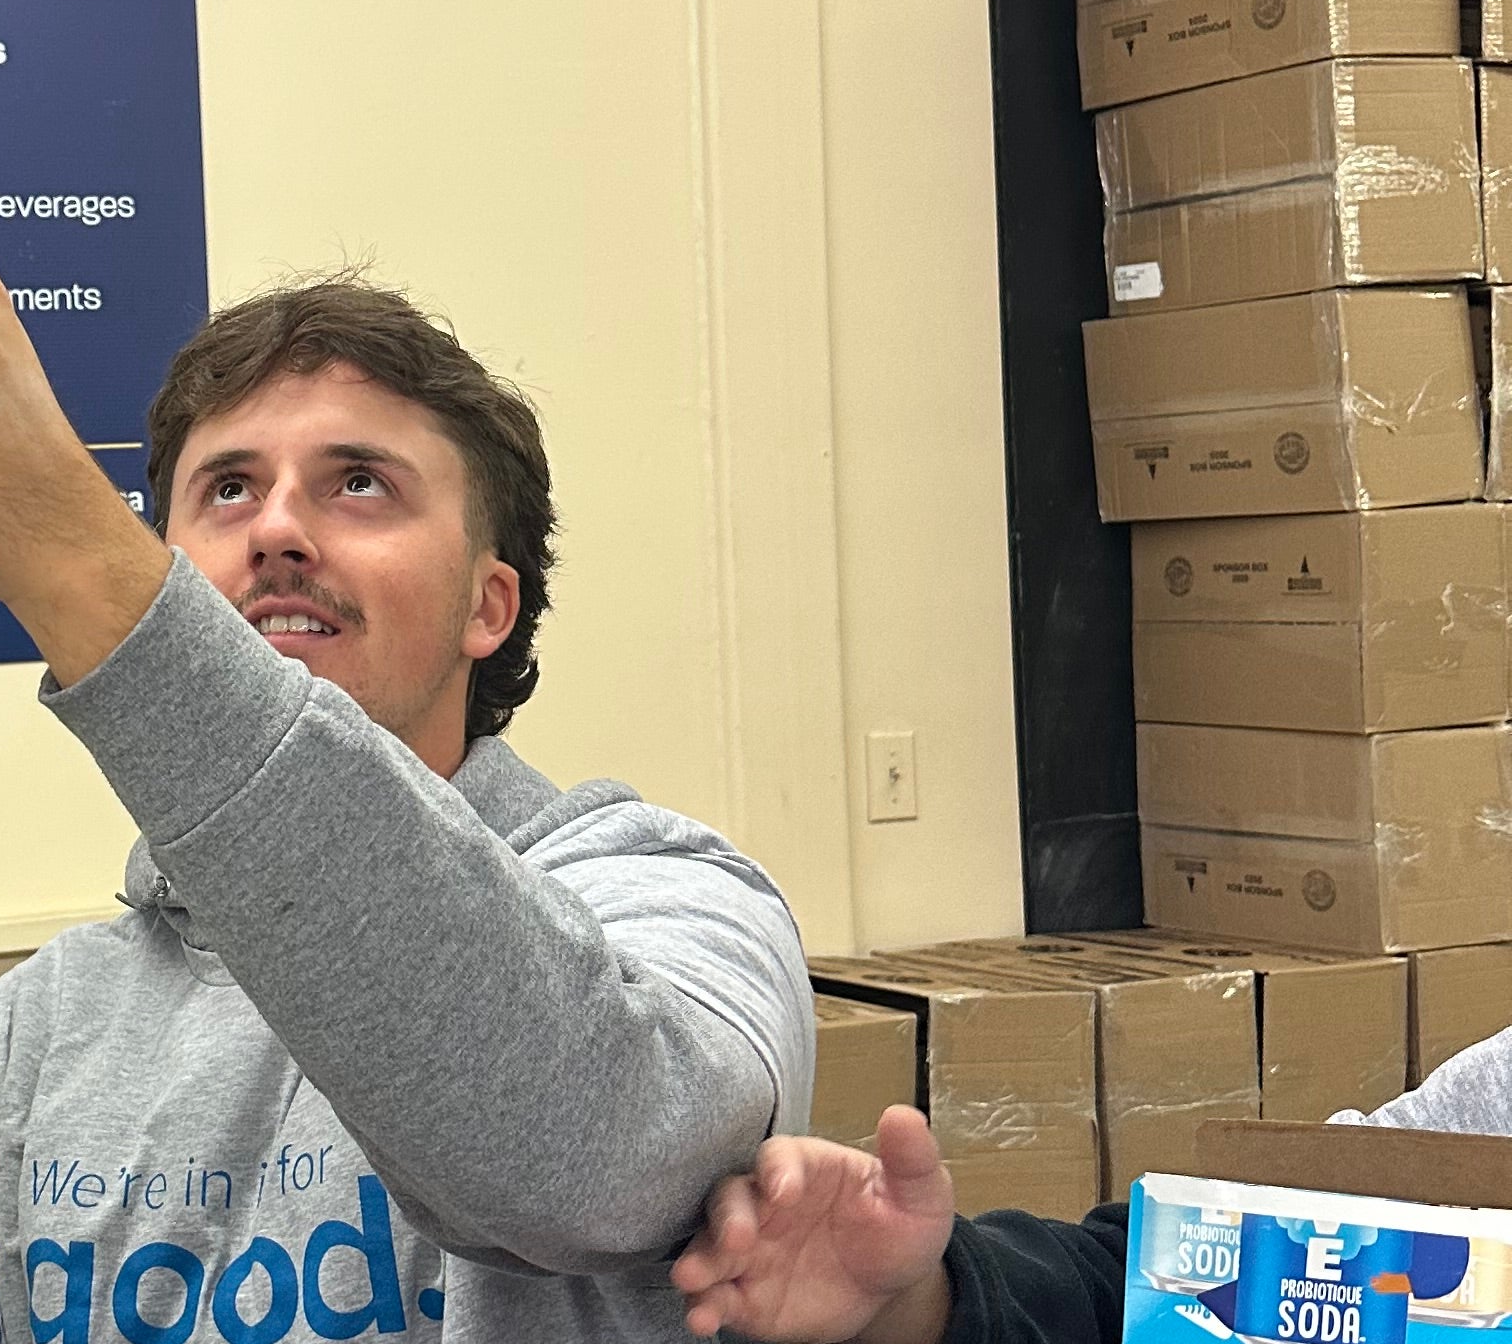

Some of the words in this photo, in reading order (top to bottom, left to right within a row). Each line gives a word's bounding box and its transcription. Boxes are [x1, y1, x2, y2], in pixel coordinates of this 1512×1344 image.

[30, 1158, 168, 1210] We're
[184, 1157, 233, 1208] in
[277, 1143, 333, 1192] for
[1280, 1279, 1363, 1305] PROBIOTIQUE
